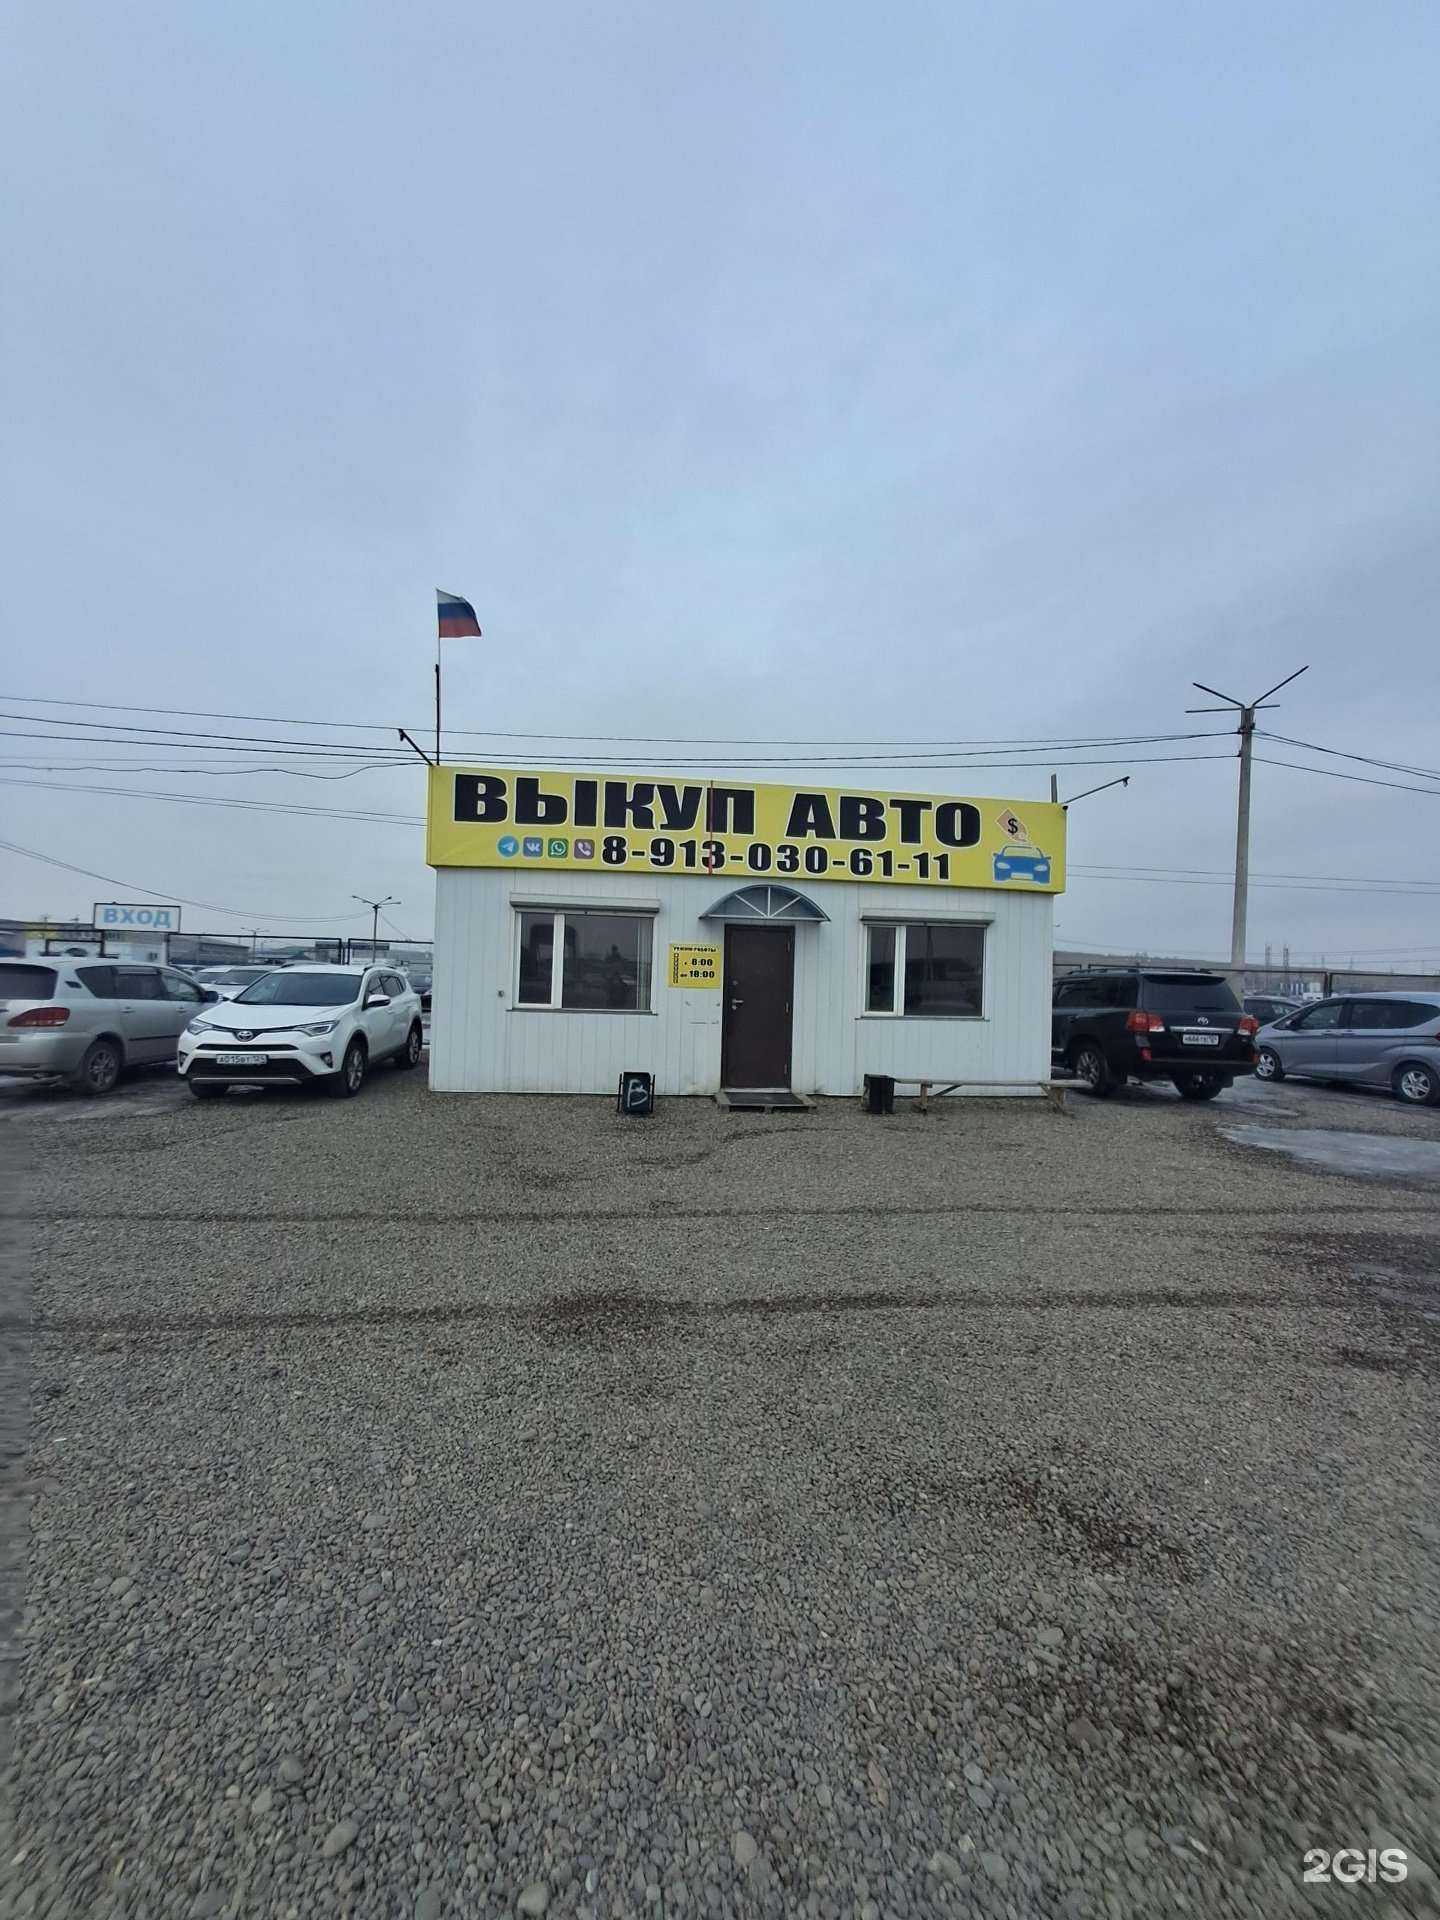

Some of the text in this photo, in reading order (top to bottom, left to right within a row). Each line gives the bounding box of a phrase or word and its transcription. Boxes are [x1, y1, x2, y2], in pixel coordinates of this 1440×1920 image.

[454, 774, 981, 847] ВЫКУП АВТО
[602, 835, 950, 880] 8-913-030-61-11
[103, 908, 171, 928] ВХОД
[691, 958, 713, 966] 8:00
[689, 970, 715, 978] 18:00
